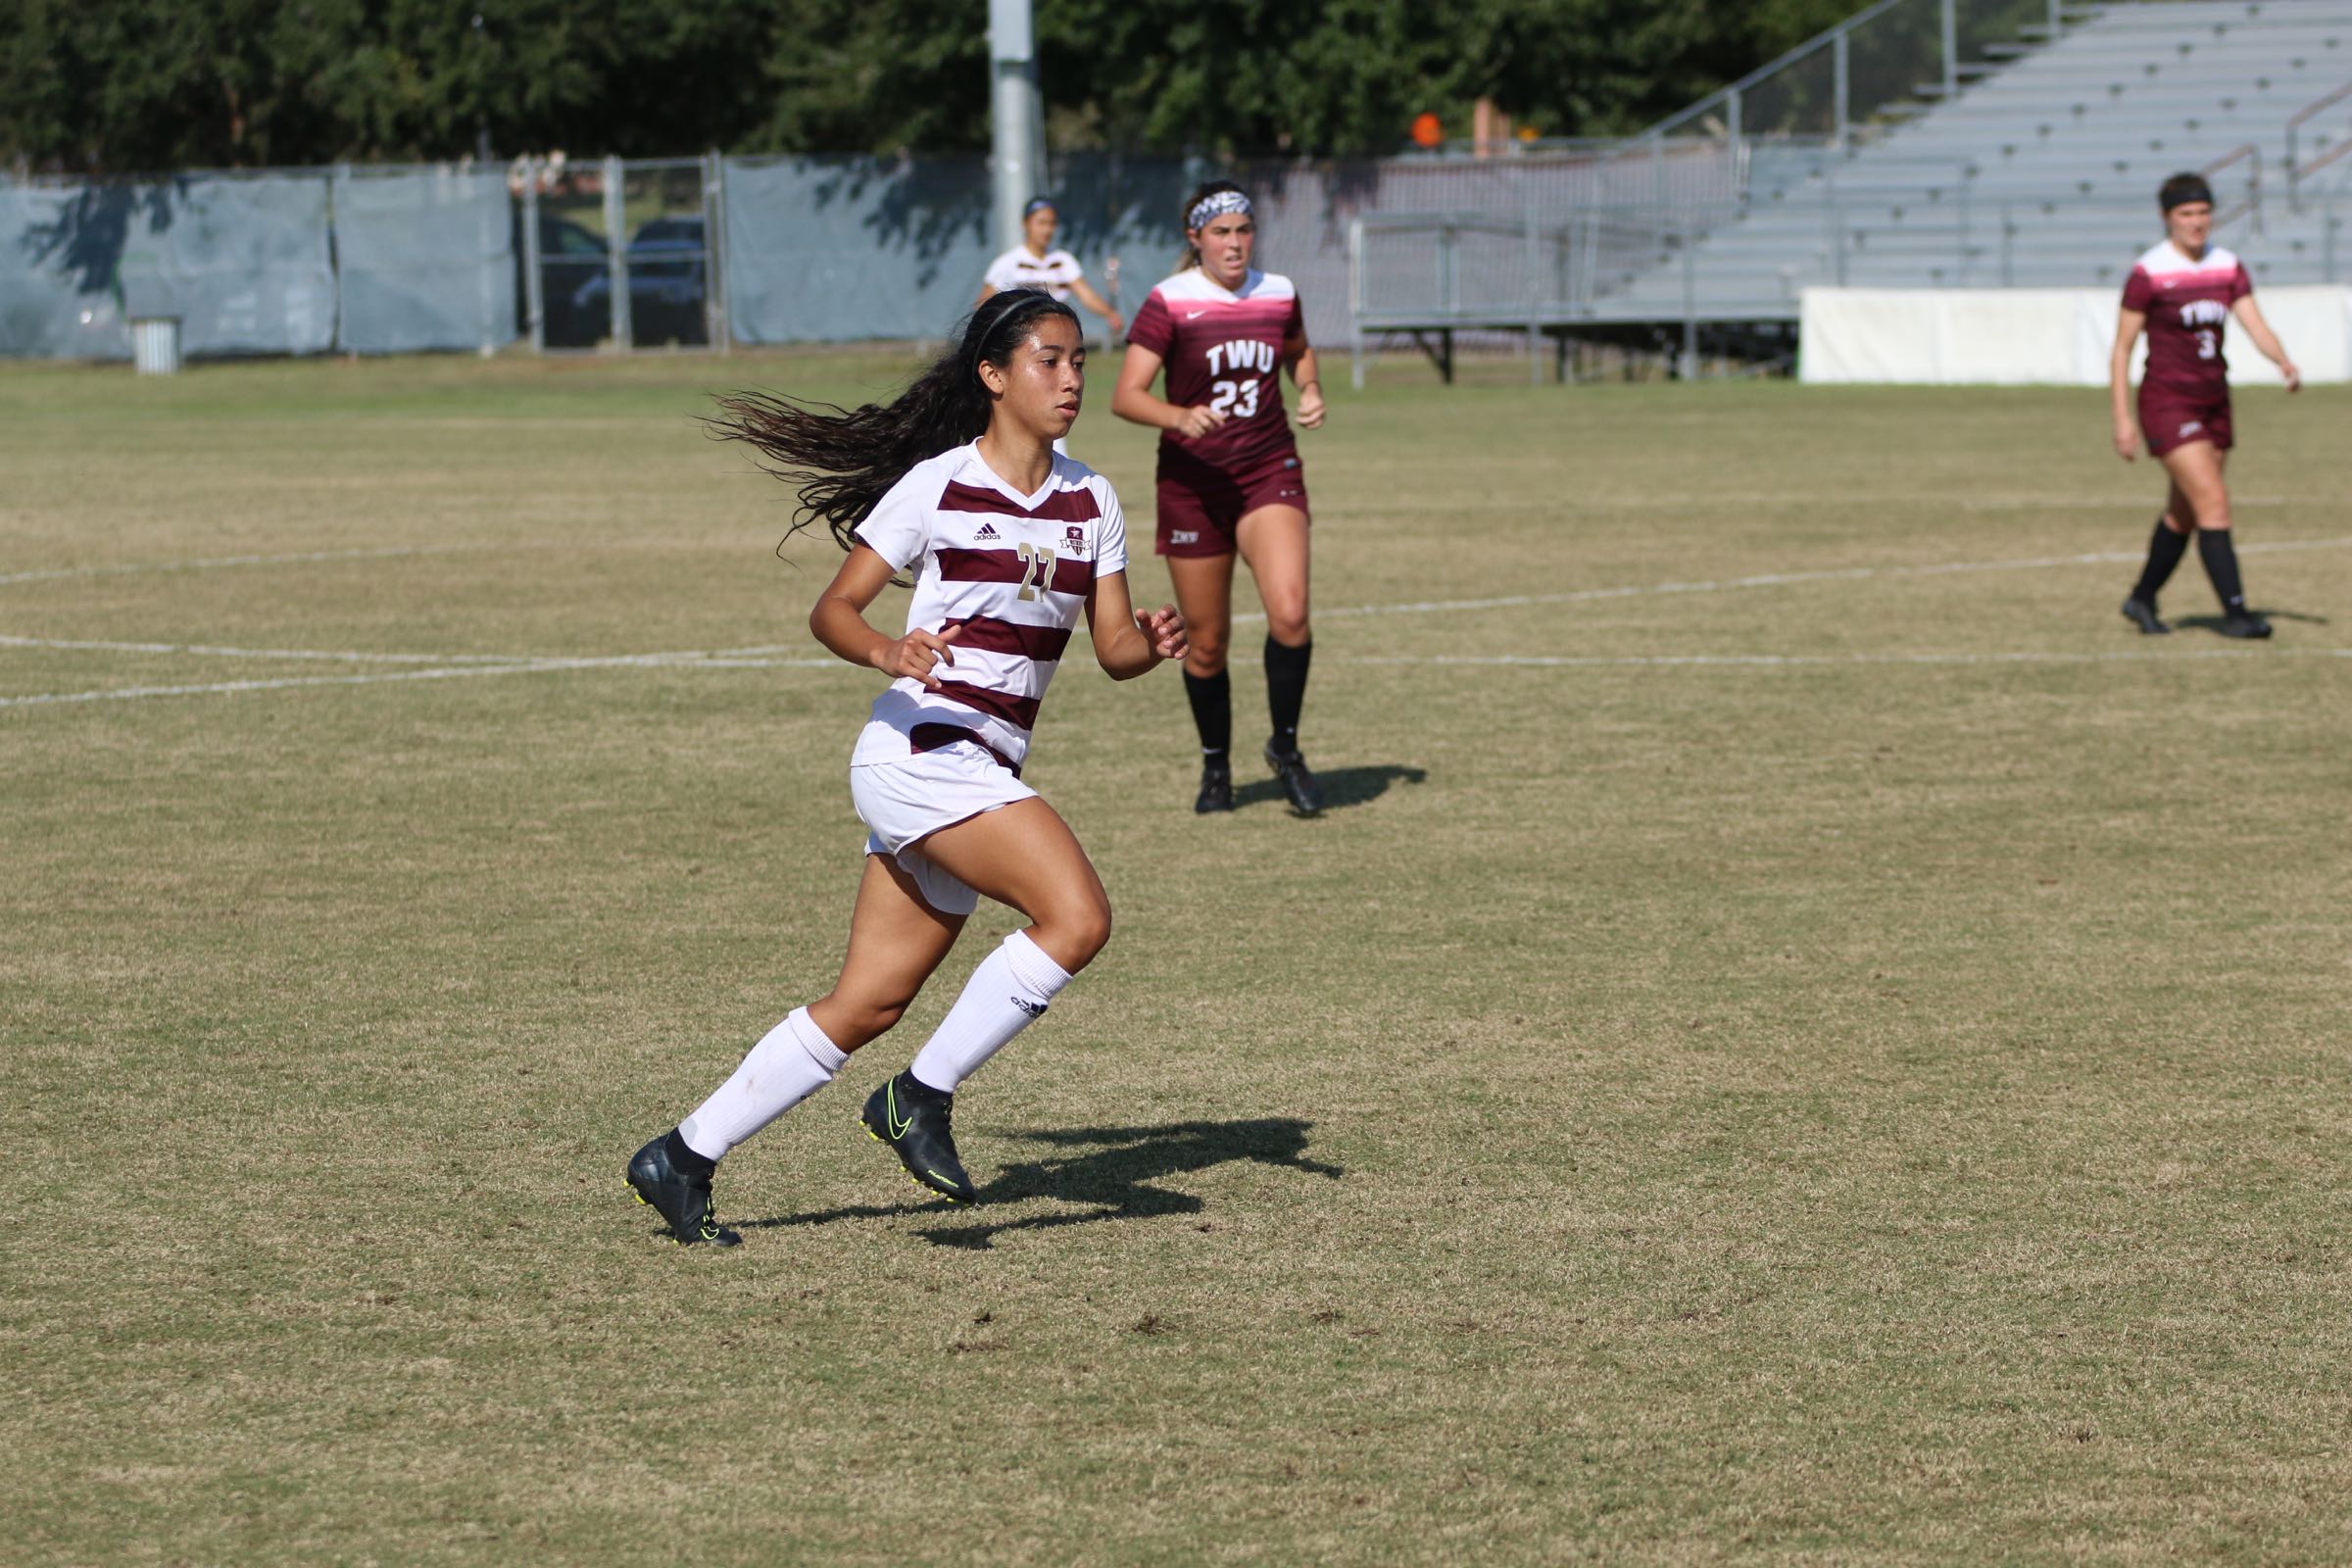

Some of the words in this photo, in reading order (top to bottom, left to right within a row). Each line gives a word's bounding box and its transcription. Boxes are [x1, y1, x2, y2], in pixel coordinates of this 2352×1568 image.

[1205, 339, 1275, 377] TWU
[2194, 329, 2217, 360] 3
[1210, 379, 1260, 417] 23
[1017, 542, 1057, 603] 27
